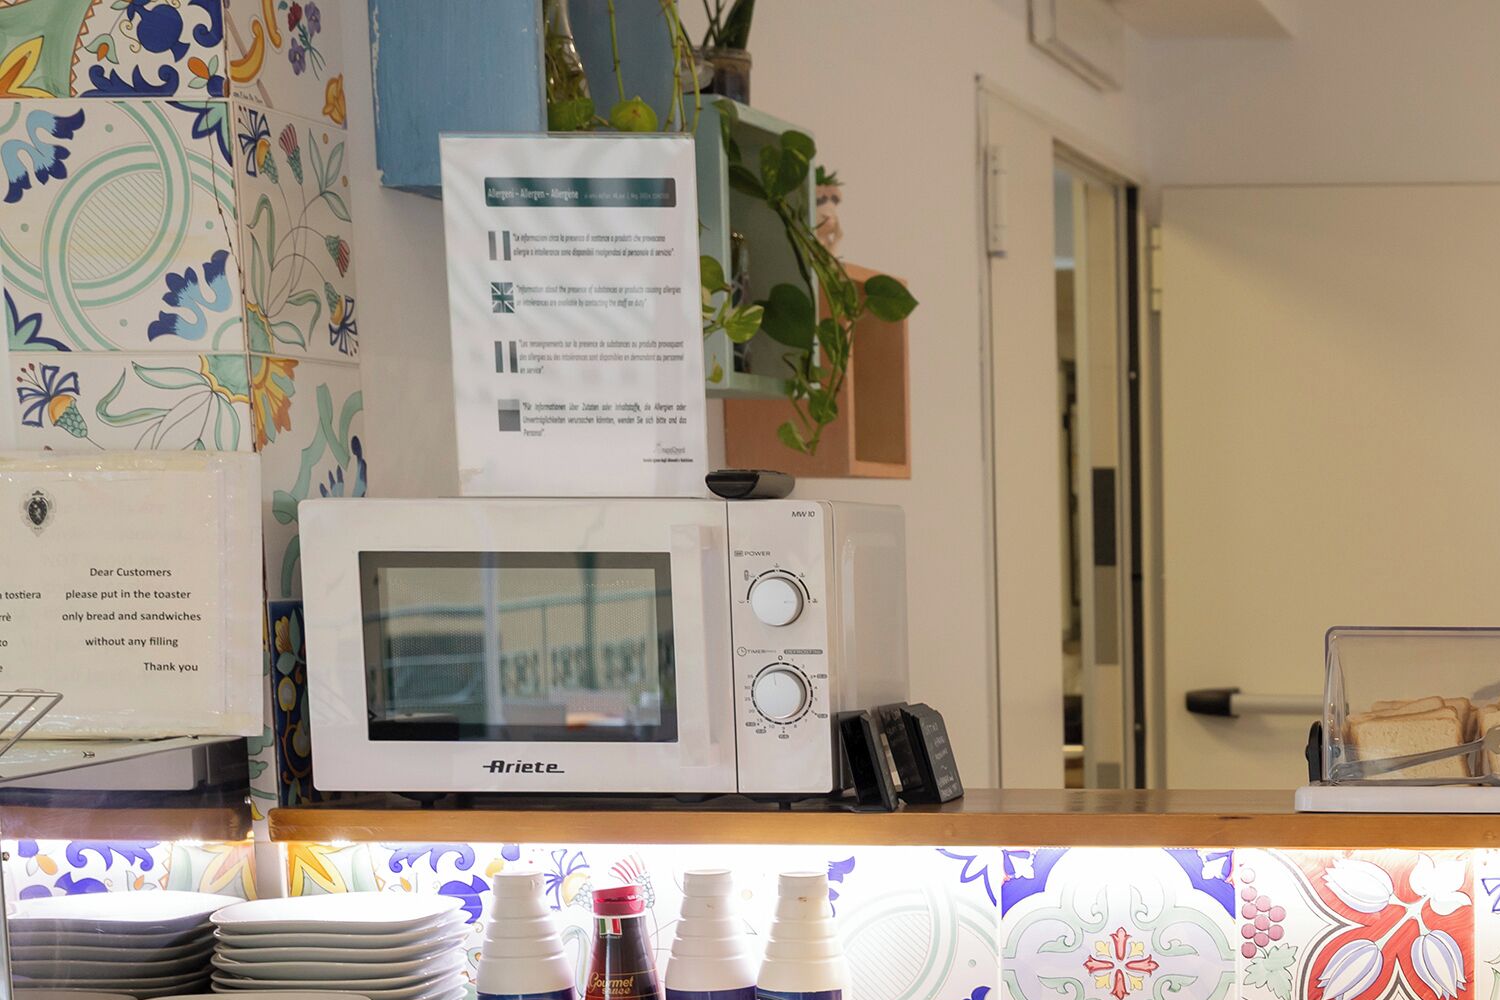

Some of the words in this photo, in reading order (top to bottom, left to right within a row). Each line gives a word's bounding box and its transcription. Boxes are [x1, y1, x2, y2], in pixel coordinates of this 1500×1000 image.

[520, 187, 545, 201] Allergen
[90, 568, 113, 577] Dear
[117, 568, 172, 577] Customers
[5, 590, 41, 599] tostiera
[66, 590, 98, 601] please
[101, 591, 118, 601] put
[121, 590, 130, 598] in
[133, 590, 150, 599] the
[154, 591, 191, 599] toaster
[62, 612, 84, 622] only
[86, 611, 115, 621] bread
[118, 611, 137, 621] and
[140, 611, 201, 621] sandwiches
[85, 637, 125, 646] without
[128, 638, 147, 648] any
[149, 637, 178, 648] filling
[144, 662, 175, 672] Thank
[178, 664, 199, 673] you
[482, 760, 565, 773] Ariete
[589, 972, 634, 992] Gourmet
